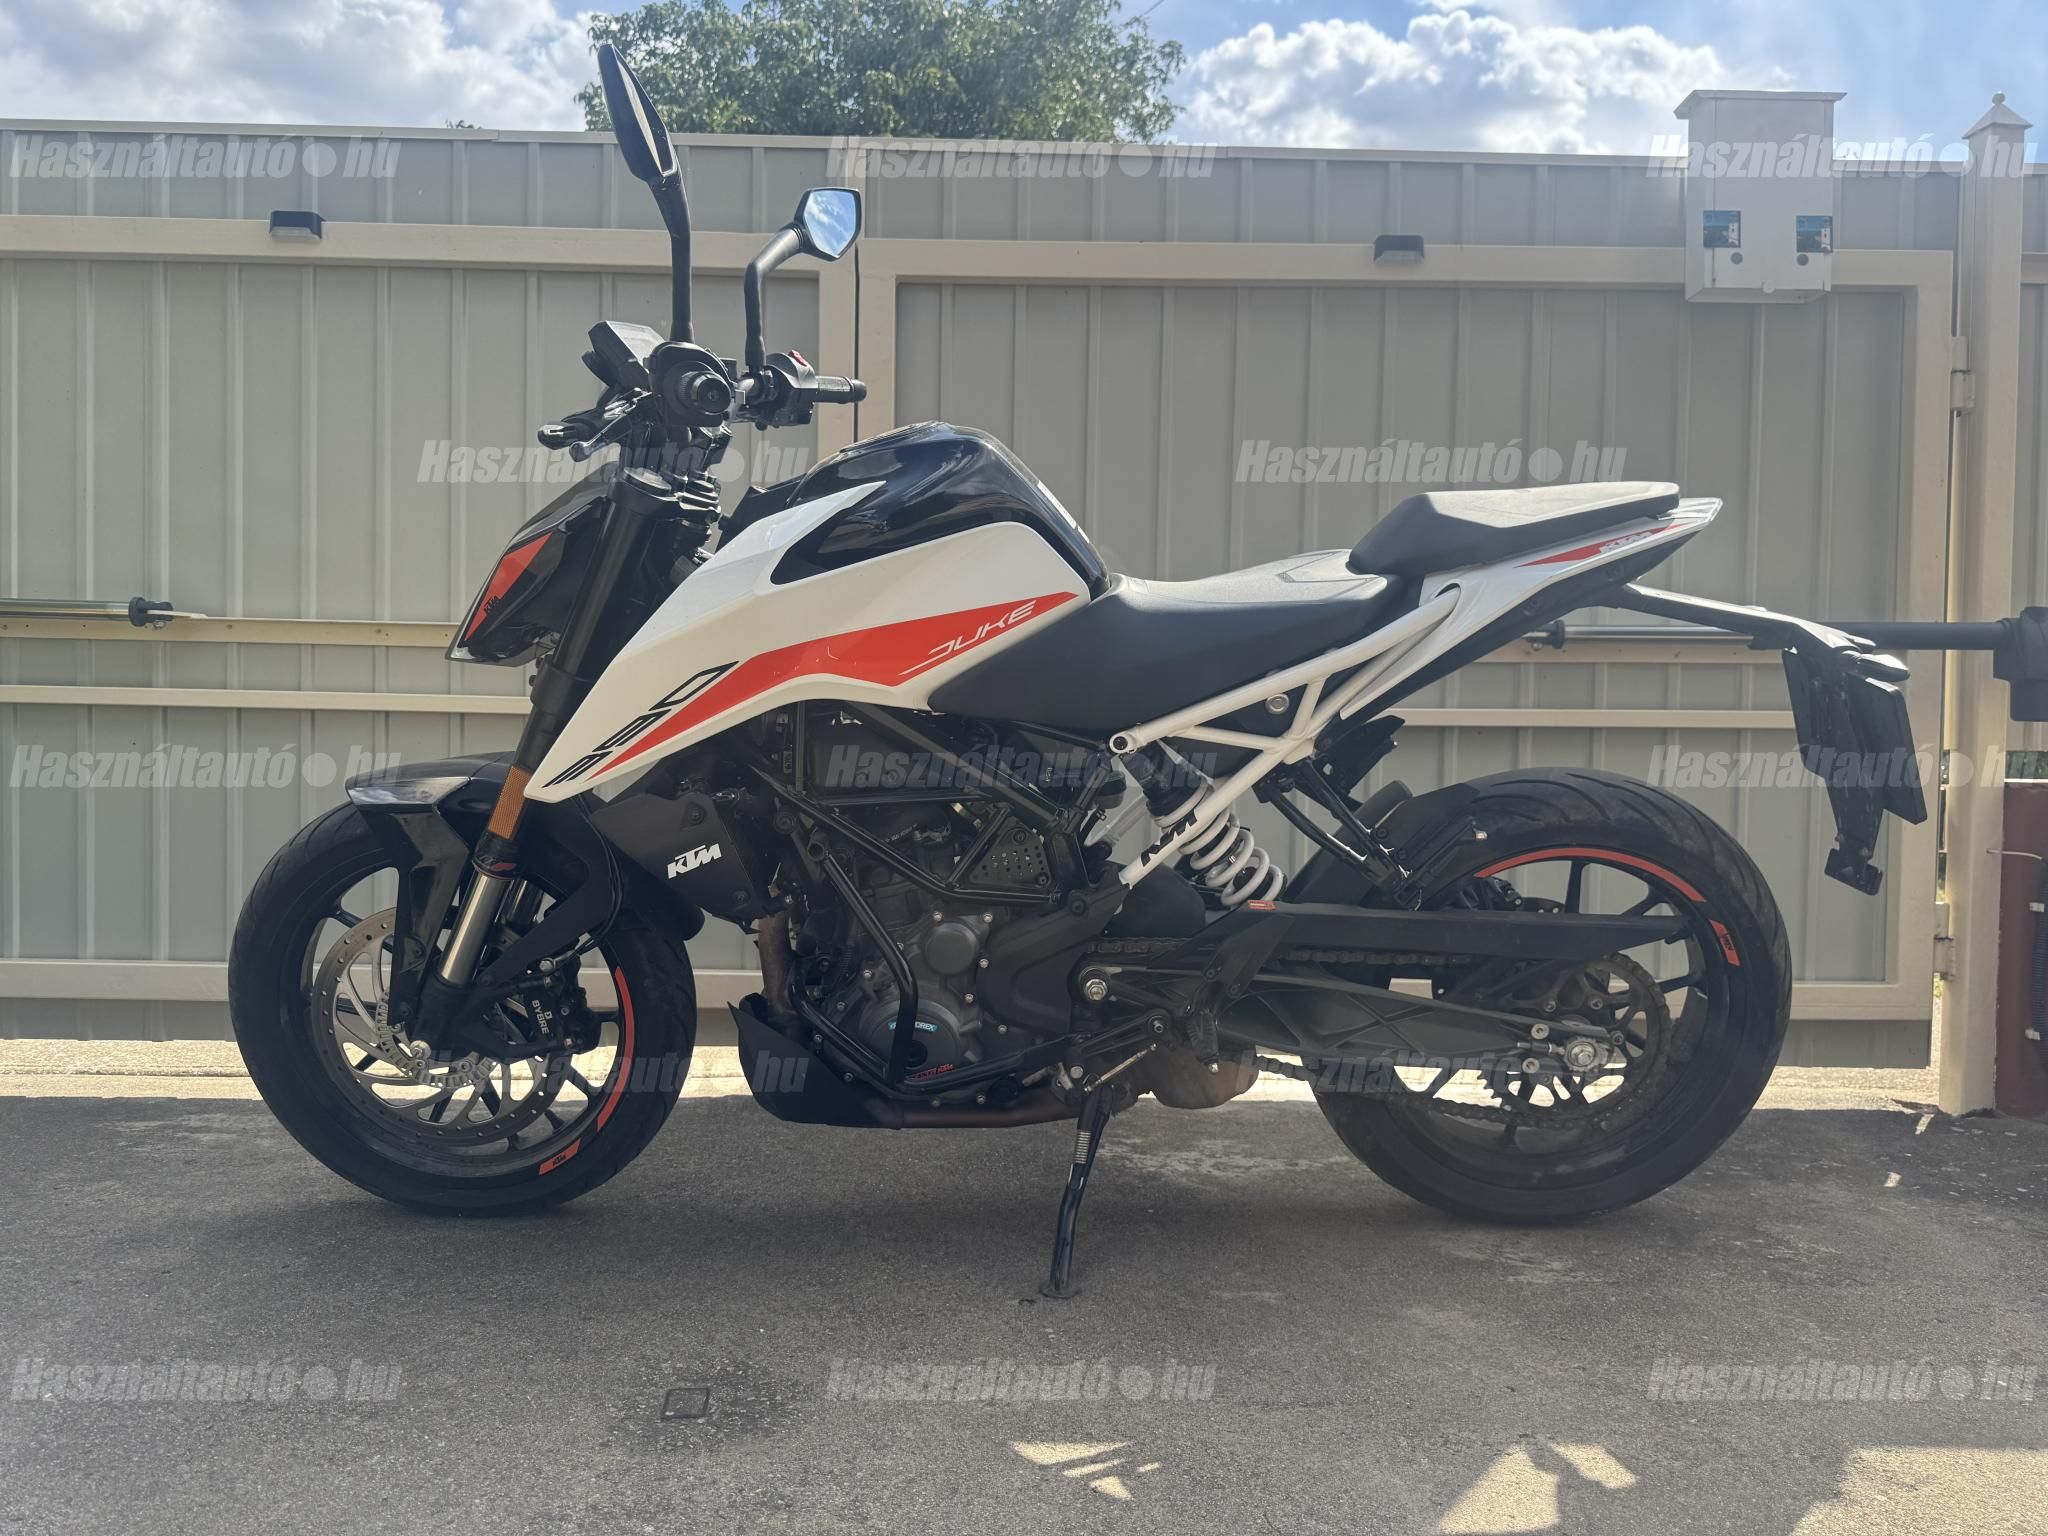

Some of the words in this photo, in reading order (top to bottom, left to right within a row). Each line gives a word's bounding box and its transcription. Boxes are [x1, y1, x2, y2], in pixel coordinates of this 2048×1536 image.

[898, 599, 1027, 676] DUKE
[541, 660, 739, 789] 390
[667, 843, 722, 879] KTM
[532, 1000, 549, 1034] BYBRE
